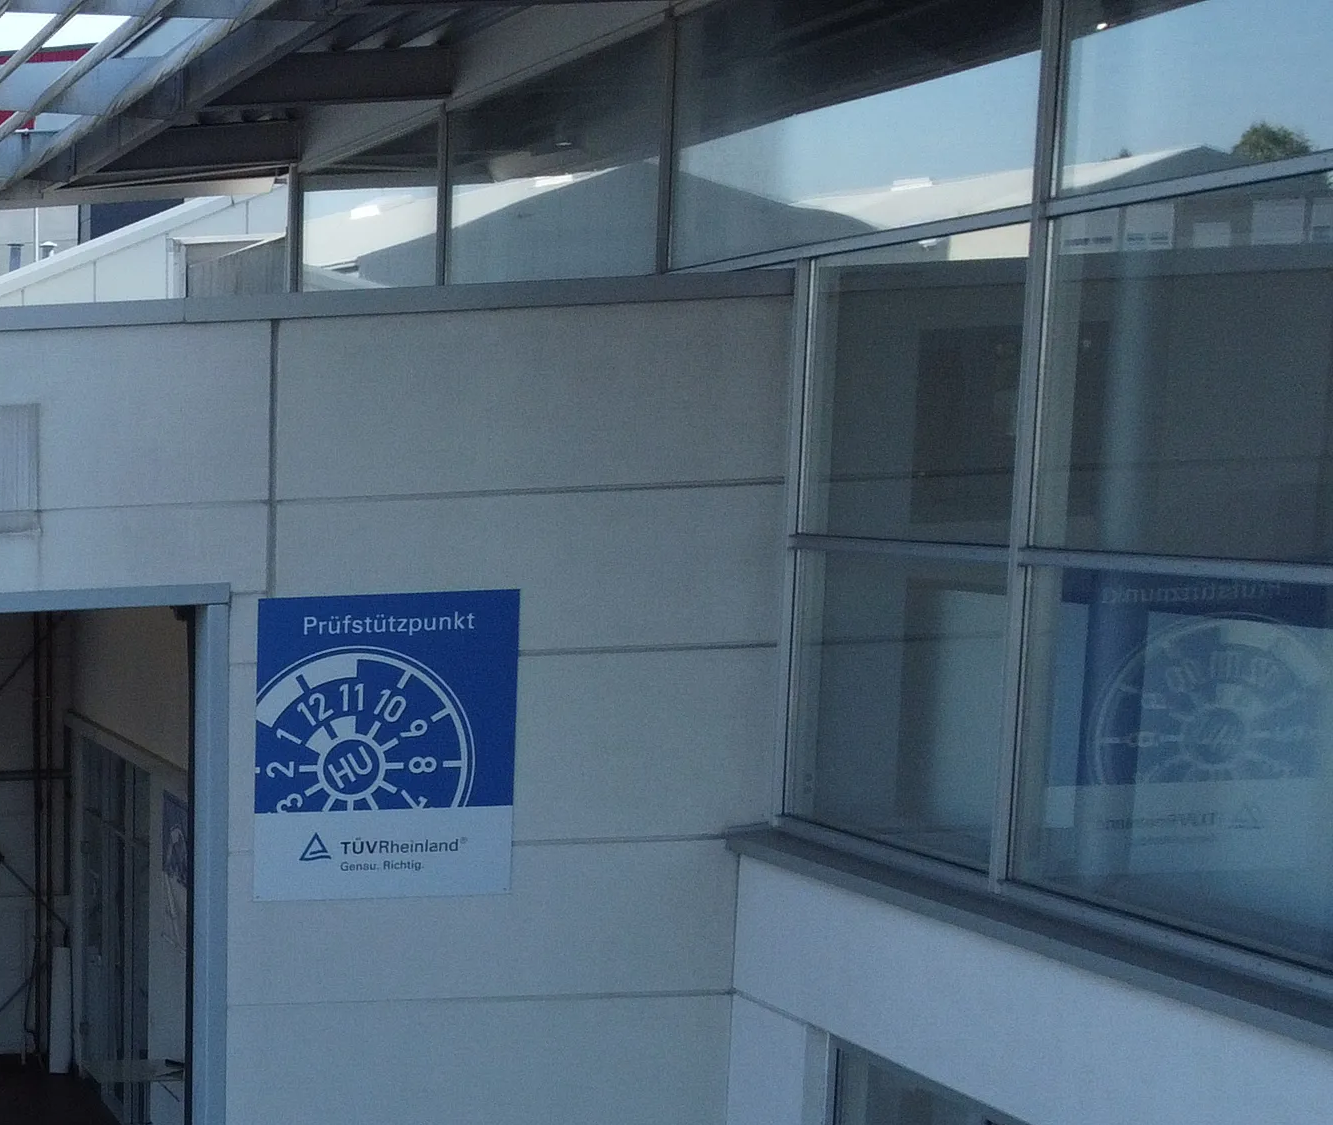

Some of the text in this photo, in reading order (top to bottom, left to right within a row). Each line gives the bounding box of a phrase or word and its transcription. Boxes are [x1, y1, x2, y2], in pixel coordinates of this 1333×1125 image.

[302, 611, 476, 636] Prüfstützpunkt
[265, 761, 295, 779] 2
[296, 692, 335, 727] 12
[339, 683, 365, 712] 11
[373, 688, 407, 723] 10
[408, 756, 438, 775] 8
[327, 745, 374, 790] HU
